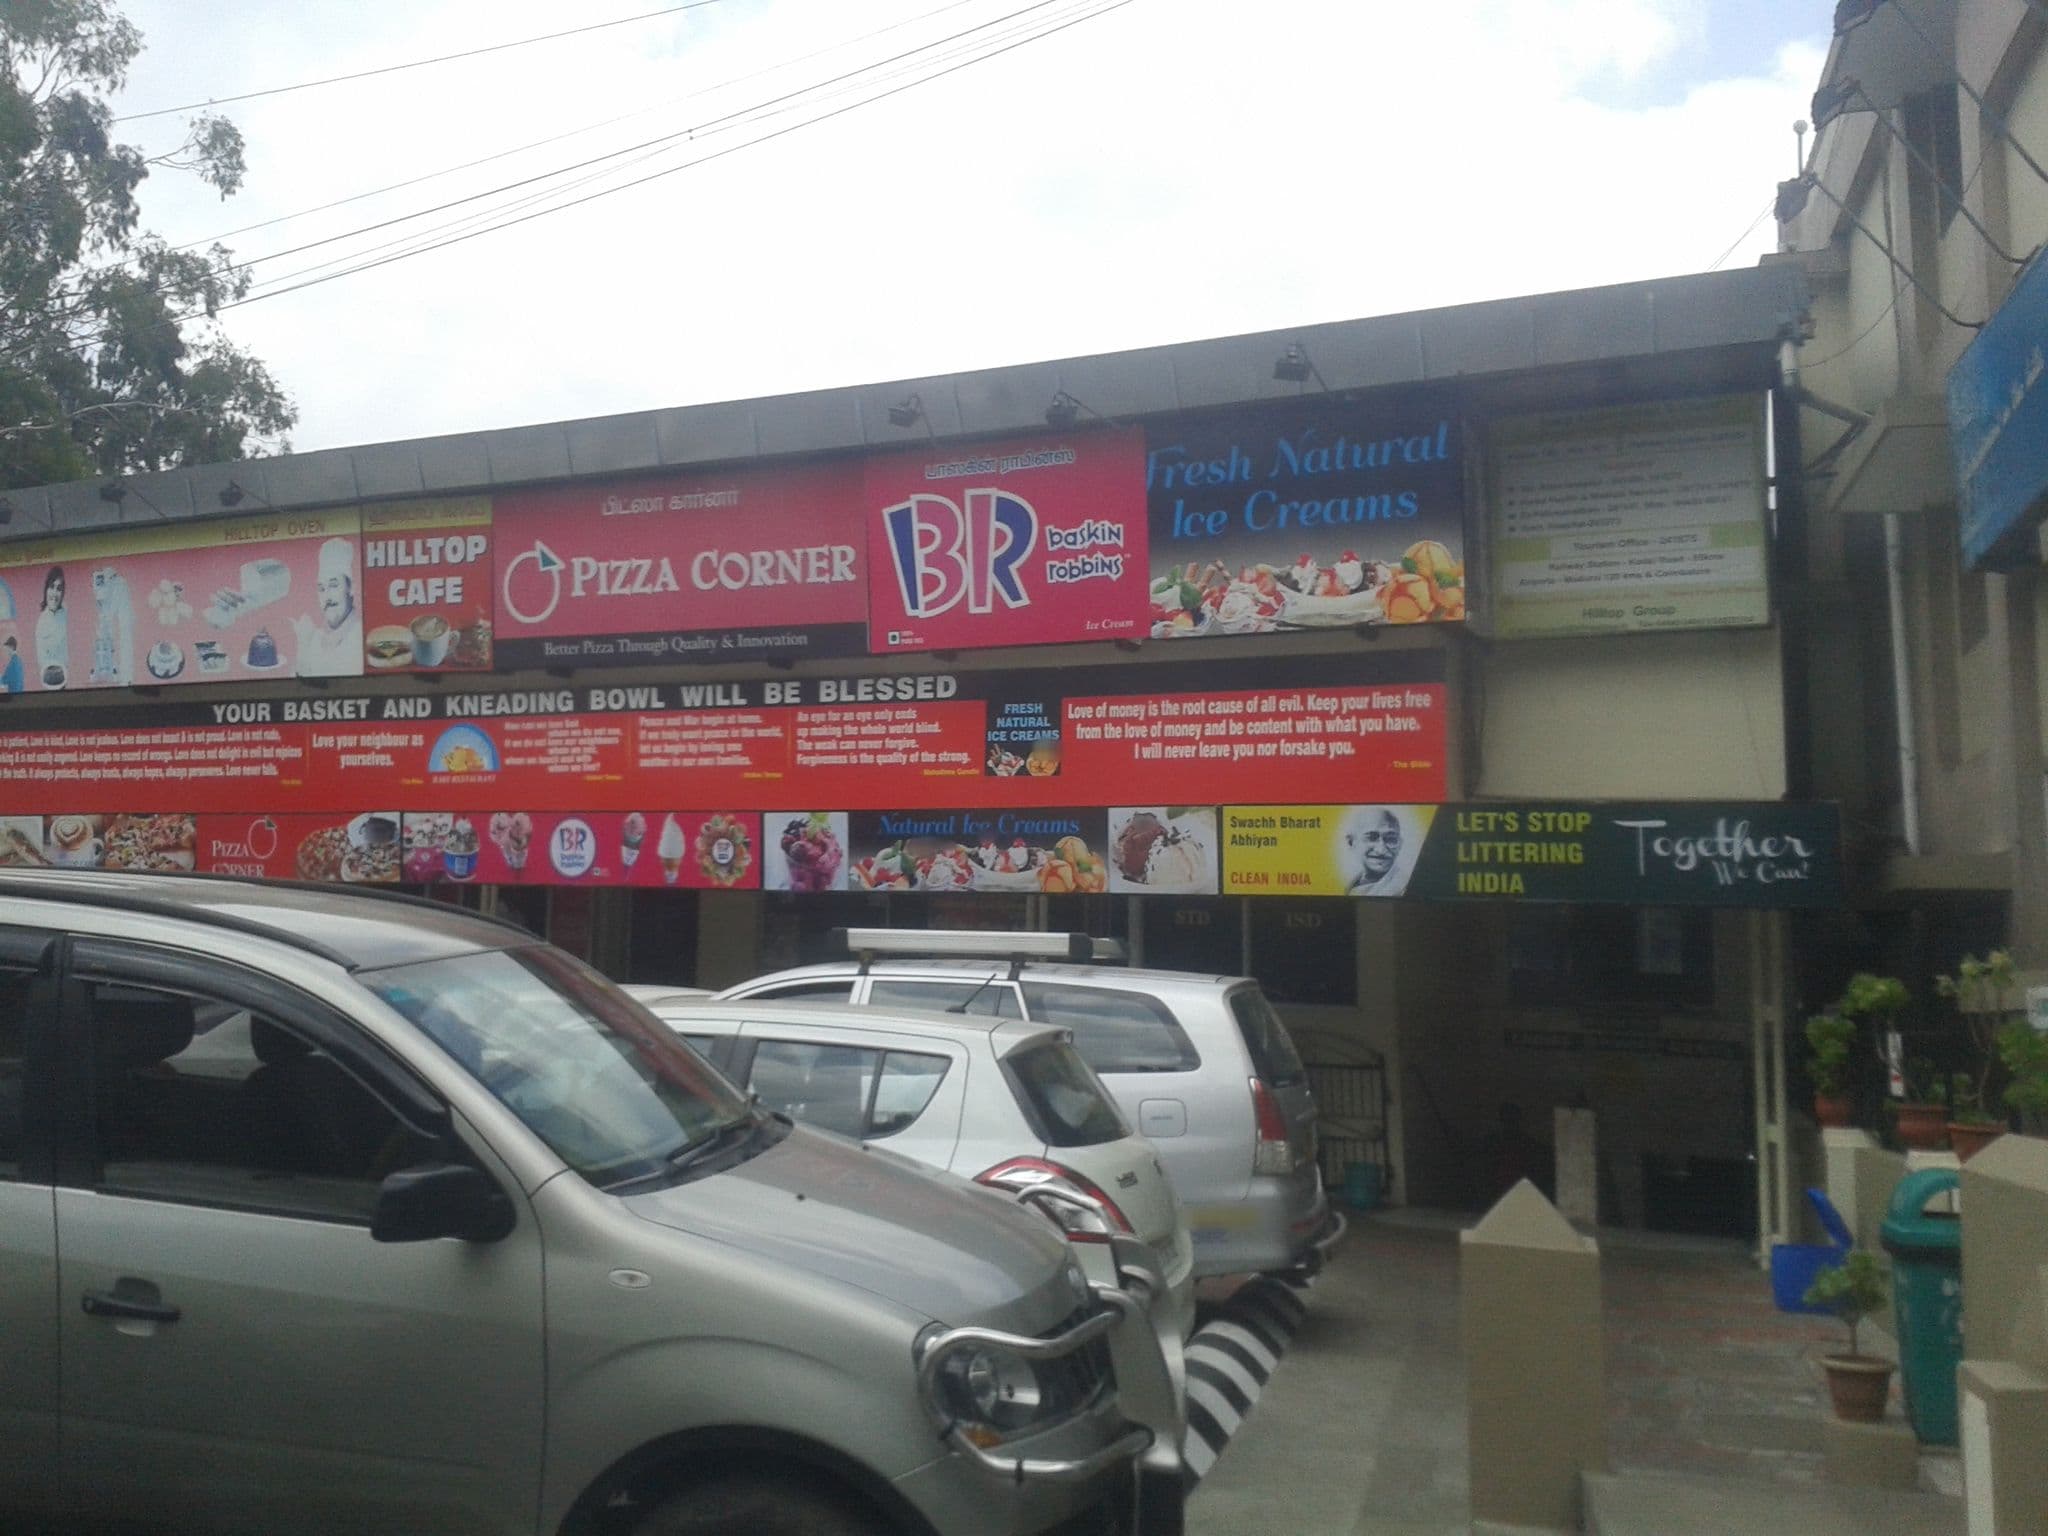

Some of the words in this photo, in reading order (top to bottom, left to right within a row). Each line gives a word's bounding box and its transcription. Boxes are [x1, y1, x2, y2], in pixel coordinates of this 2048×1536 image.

[1147, 445, 1251, 491] Fresh
[1269, 420, 1449, 480] Natural
[1172, 499, 1228, 539] Ice
[1244, 489, 1418, 531] Creams
[224, 523, 280, 541] HILLTOP
[288, 519, 326, 537] OVEN
[366, 534, 487, 568] HILLTOP
[388, 575, 464, 607] CAFE
[544, 641, 580, 656] Better
[583, 640, 614, 655] Pizza
[617, 638, 669, 657] Through
[671, 636, 718, 654] Quality
[721, 637, 734, 649] &
[737, 633, 809, 648] Innovation
[213, 704, 271, 724] YOUR
[283, 699, 371, 722] BASKET
[383, 697, 432, 720] AND
[446, 690, 575, 716] KNEADING
[589, 687, 665, 711] BOWL
[681, 684, 748, 707] WILL
[764, 682, 801, 704] BE
[818, 675, 958, 702] BLESSED
[1004, 703, 1042, 714] FRESH
[1067, 703, 1093, 719] Love
[1095, 702, 1108, 717] of
[1109, 703, 1145, 721] money
[1148, 700, 1159, 717] is
[1161, 700, 1180, 716] the
[1182, 699, 1205, 716] root
[1208, 700, 1242, 715] cause
[1246, 696, 1259, 713] of
[1261, 695, 1276, 713] all
[1279, 695, 1304, 712] evil.
[1307, 694, 1338, 715] Keep
[1341, 694, 1369, 714] your
[1372, 691, 1402, 709] lives
[1405, 690, 1432, 708] free
[996, 717, 1050, 728] NATURAL
[1076, 723, 1101, 739] from
[1104, 722, 1121, 738] the
[1124, 722, 1148, 738] love
[1150, 721, 1163, 737] of
[1164, 723, 1201, 740] money
[1204, 719, 1227, 736] and
[1229, 718, 1243, 735] be
[1246, 717, 1293, 735] content
[1296, 716, 1322, 733] with
[1326, 716, 1357, 733] what
[1360, 717, 1382, 736] you
[1386, 713, 1421, 731] have.
[312, 733, 335, 748] Love
[336, 735, 358, 750] your
[360, 731, 409, 750] neighbour
[411, 734, 424, 747] as
[987, 731, 1006, 742] ICE
[1009, 730, 1060, 742] CREAMS
[1134, 743, 1139, 759] I
[1141, 742, 1162, 759] will
[1164, 743, 1197, 759] never
[1199, 742, 1230, 758] leave
[1233, 742, 1254, 761] you
[1257, 742, 1277, 757] nor
[1280, 739, 1326, 756] forsake
[1329, 741, 1355, 760] you.
[880, 813, 956, 835] Natural
[962, 813, 990, 834] Ice
[997, 813, 1080, 834] Creams
[1230, 816, 1276, 829] Swachh
[1280, 816, 1321, 829] Bharat
[1457, 811, 1519, 833] LET'S
[1528, 811, 1592, 833] STOP
[212, 840, 250, 857] PIZZA
[1230, 833, 1278, 848] Abhiyan
[1612, 817, 1815, 877] Together
[1457, 842, 1584, 864] LITTERING
[1230, 871, 1269, 886] CLEAN
[1277, 871, 1313, 886] INDIA
[1457, 872, 1525, 895] INDIA
